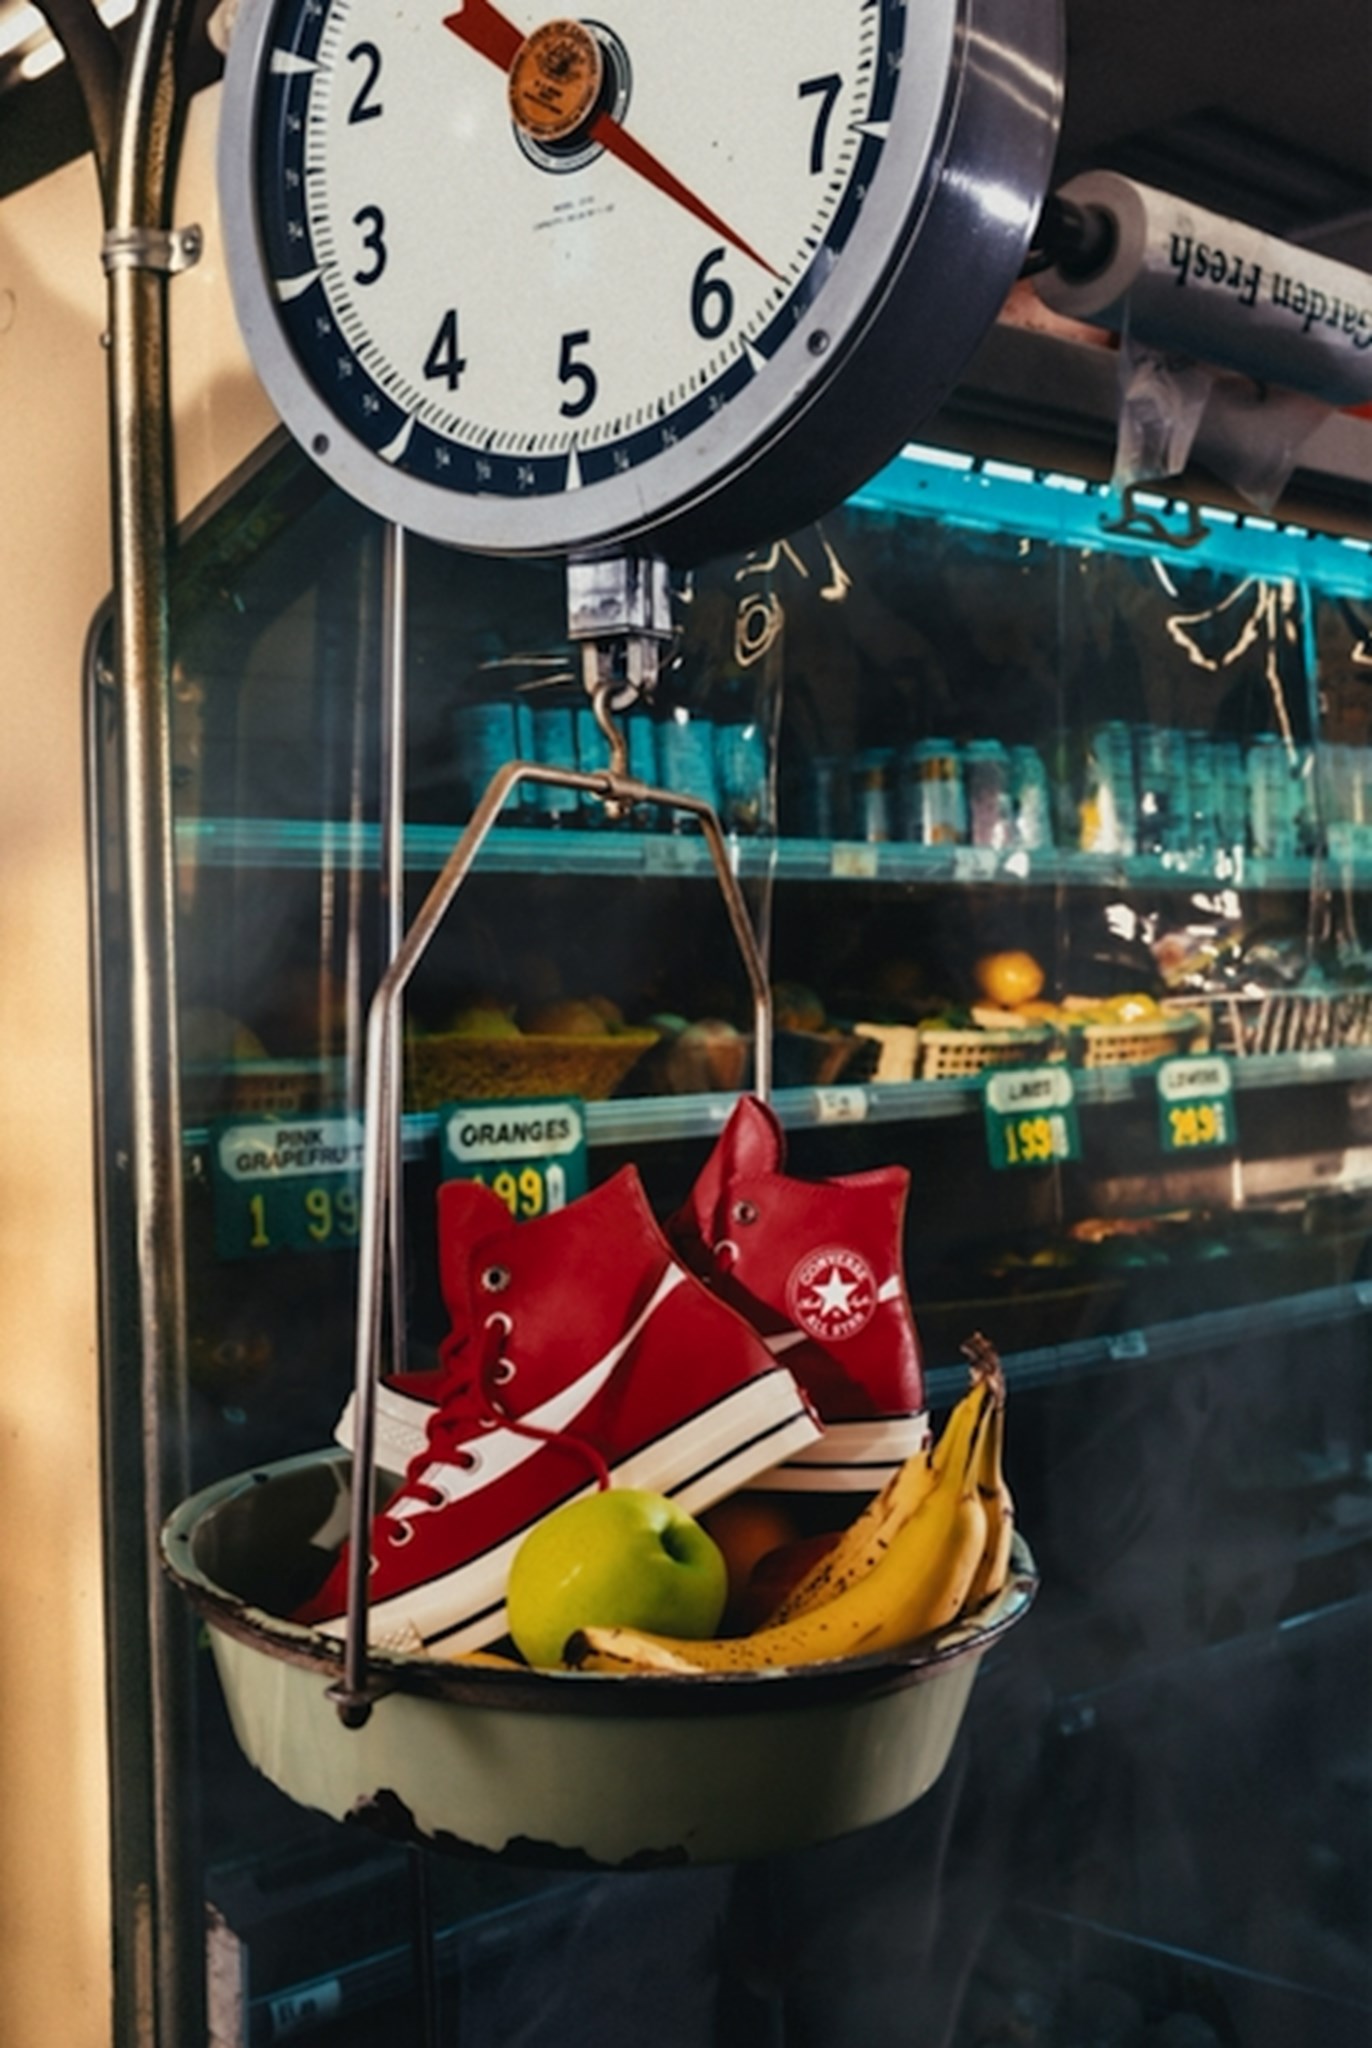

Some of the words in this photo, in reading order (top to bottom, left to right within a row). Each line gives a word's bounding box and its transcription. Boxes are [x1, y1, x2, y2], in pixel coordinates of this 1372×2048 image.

[347, 41, 383, 125] 2
[798, 72, 844, 175] 7
[353, 205, 388, 286] 3
[1169, 231, 1263, 309] Fresh
[690, 248, 735, 341] 6
[422, 308, 467, 392] 4
[558, 329, 598, 418] 5
[276, 1128, 324, 1149] PINK
[460, 1118, 571, 1148] ORANGES
[473, 1166, 543, 1217] 99
